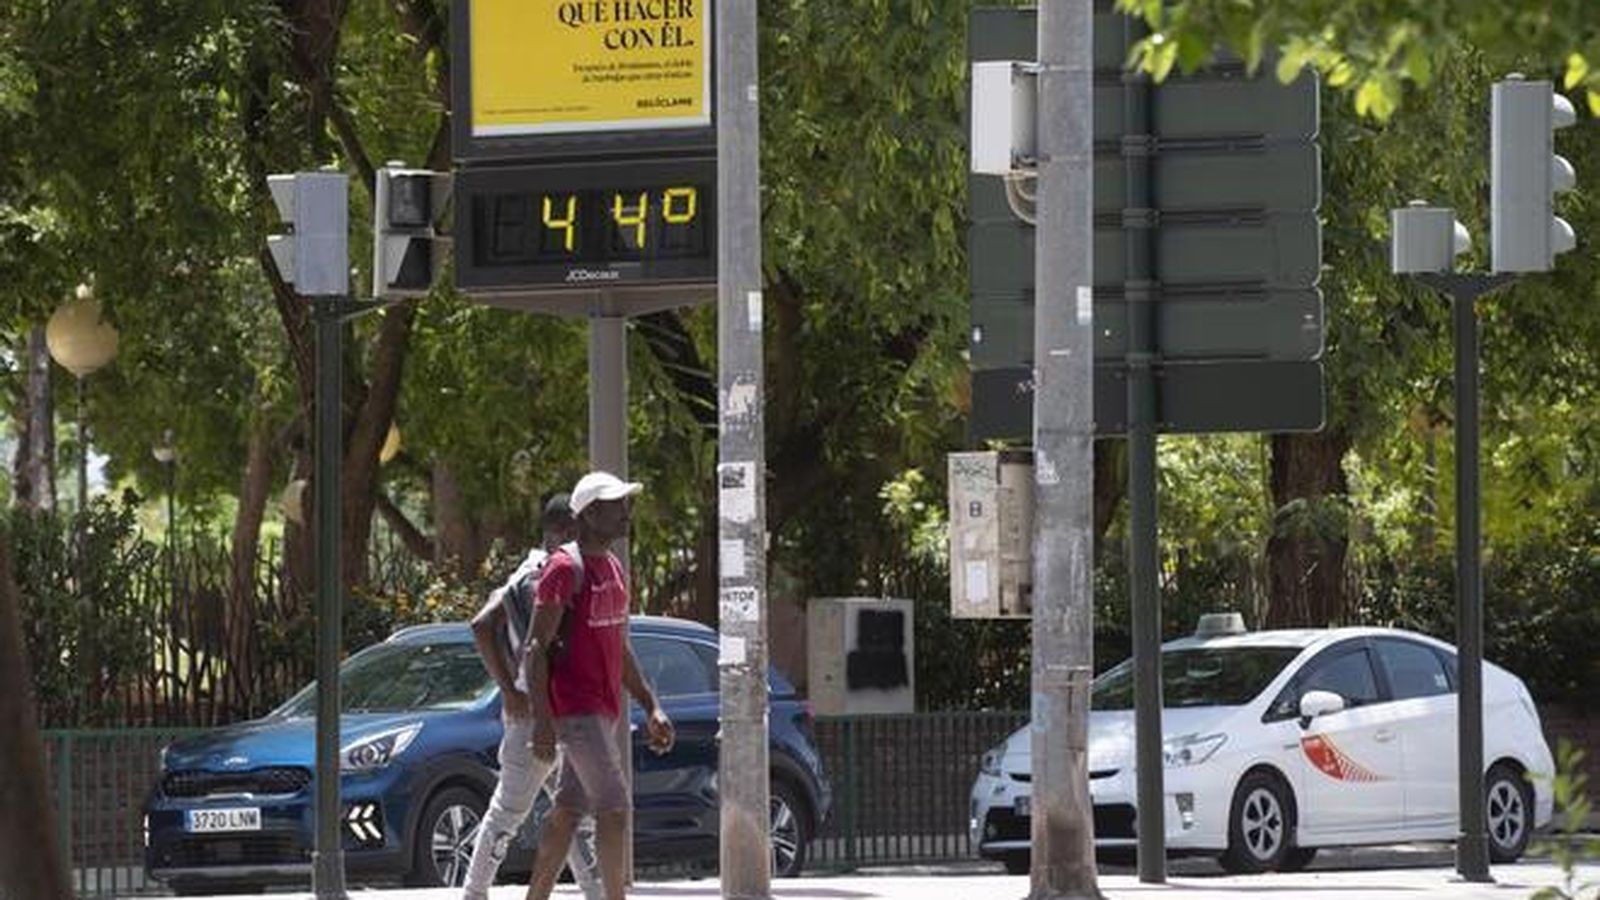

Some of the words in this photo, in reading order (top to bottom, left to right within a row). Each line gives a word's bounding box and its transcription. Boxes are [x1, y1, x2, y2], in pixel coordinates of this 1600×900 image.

[614, 0, 693, 22] HACER
[604, 28, 654, 50] CON
[661, 21, 694, 47] ÉL.
[193, 811, 227, 830] 3720
